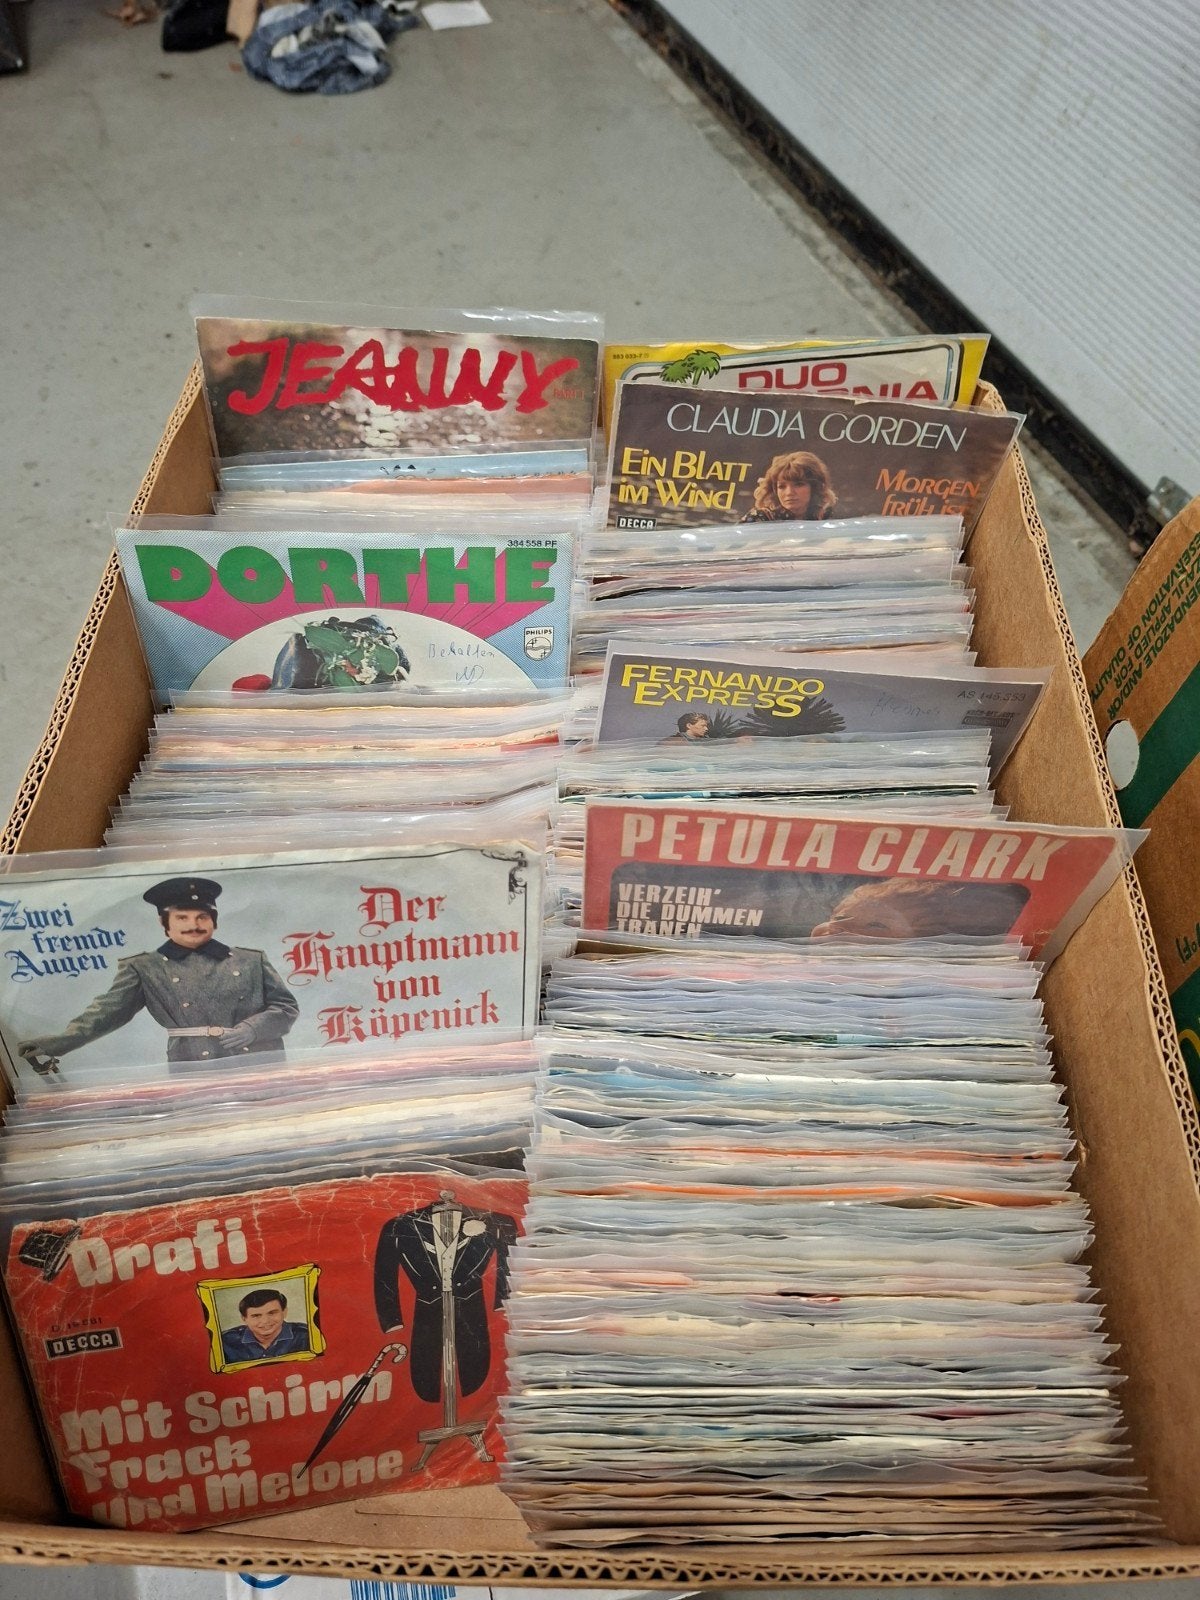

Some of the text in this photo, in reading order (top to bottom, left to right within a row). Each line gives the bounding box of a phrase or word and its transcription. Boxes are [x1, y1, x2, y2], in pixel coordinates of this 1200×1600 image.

[227, 338, 579, 415] JEANNY
[738, 362, 847, 389] DUO
[666, 403, 967, 452] CLAUDIA GORDEN
[619, 517, 655, 530] DECCA
[135, 545, 558, 604] DORTHE
[1127, 624, 1142, 650] OF
[1133, 596, 1172, 660] APPLIED
[621, 664, 825, 697] FERNANDO
[1106, 662, 1143, 721] AND/OR
[1113, 656, 1134, 690] FOR
[633, 682, 804, 718] EXPRESS
[619, 813, 1067, 882] PETULA CLARK
[0, 900, 74, 931] Zwei
[358, 885, 447, 936] Der
[616, 901, 764, 927] DIE DUMMEN
[31, 927, 127, 954] fremde
[282, 929, 521, 986] Hauptmann
[4, 949, 109, 983] Augen
[373, 973, 441, 1004] von
[317, 990, 500, 1047] Köpenick
[68, 1218, 248, 1287] Drafi
[52, 1333, 114, 1354] DECCA
[59, 1370, 393, 1453] Mit Schirm
[68, 1436, 252, 1493] Frack
[205, 1449, 404, 1512] Melone
